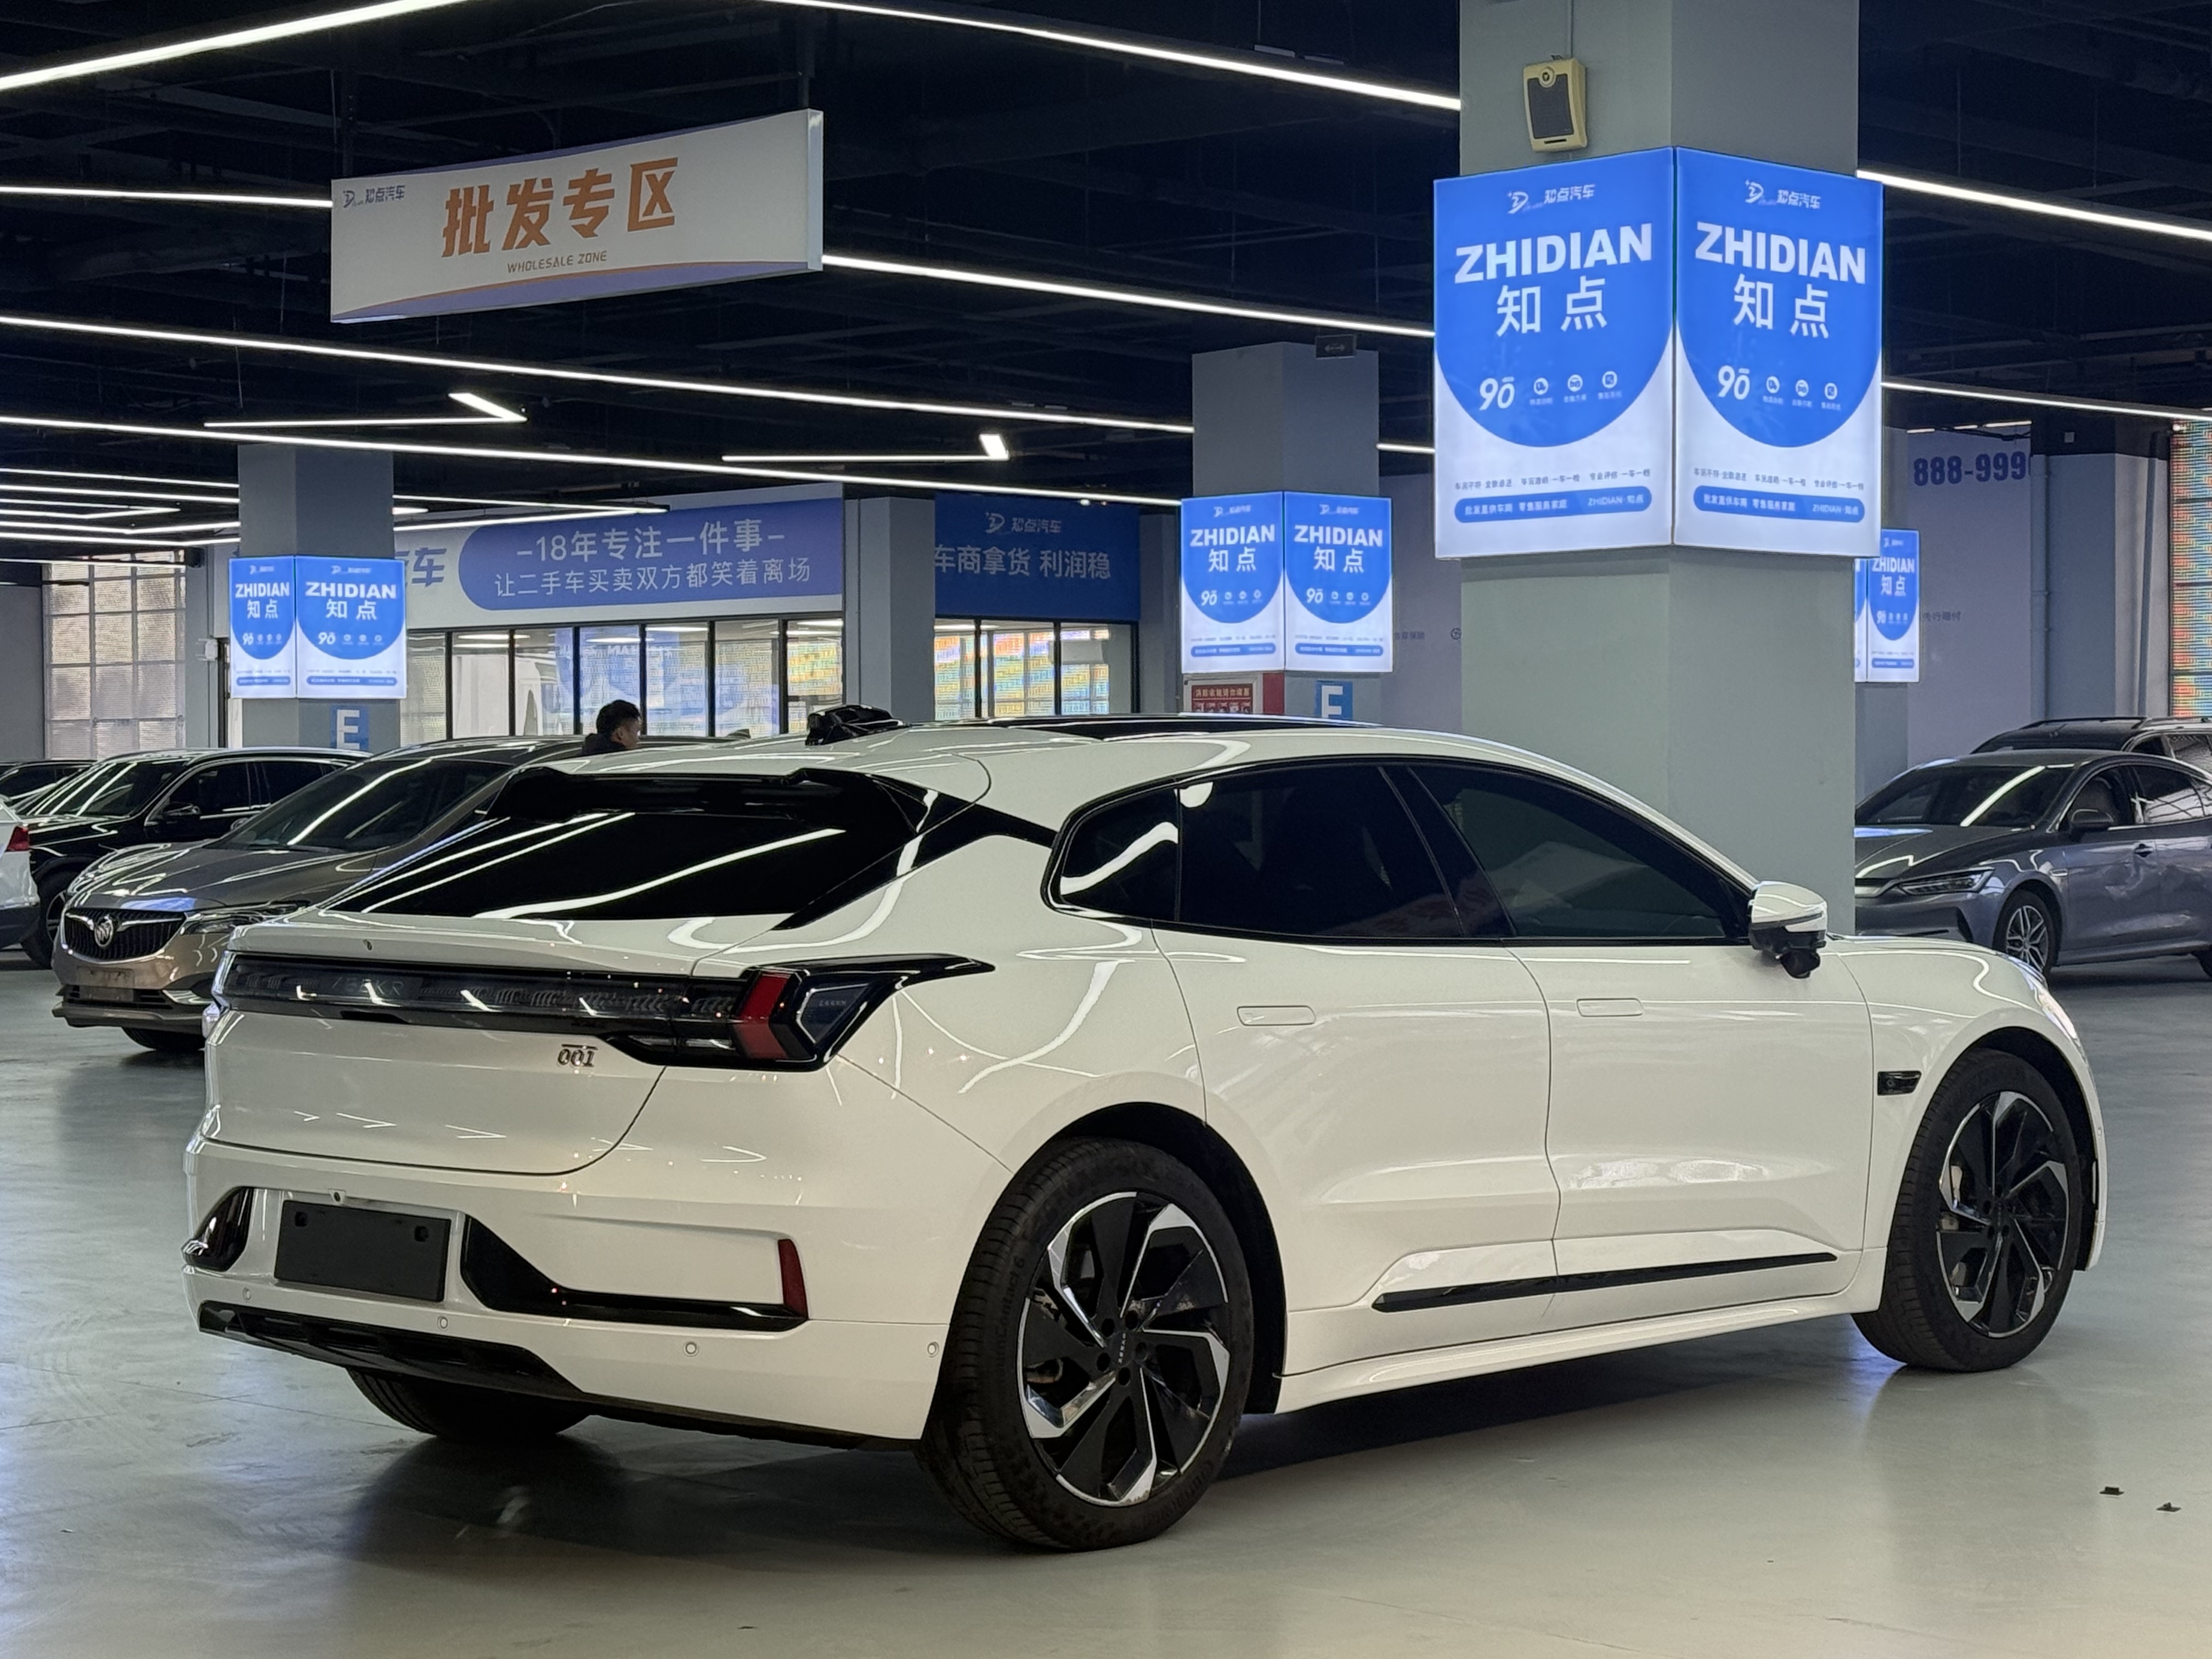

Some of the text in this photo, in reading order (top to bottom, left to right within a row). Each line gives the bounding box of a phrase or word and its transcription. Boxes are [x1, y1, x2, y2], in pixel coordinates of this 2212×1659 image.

[365, 185, 405, 204] 知点汽车
[1544, 184, 1595, 205] 知点汽车
[1776, 189, 1821, 209] 知点汽车
[442, 157, 678, 257] 批发专区
[507, 250, 607, 273] WHOLESALE ZONE
[1455, 223, 1652, 284] ZHIDIAN
[1695, 222, 1865, 284] ZHIDIAN
[1496, 275, 1607, 337] 知点
[1734, 274, 1829, 338] 知点
[1479, 376, 1515, 410] 90
[1717, 365, 1750, 400] 90
[1914, 451, 2031, 486] 888-999
[1012, 517, 1062, 533] 知点汽车
[1190, 524, 1275, 547] ZHIDIAN
[1294, 524, 1383, 546] ZHIDIAN
[395, 548, 447, 588] 车
[934, 544, 1111, 579] 车商拿货 利润稳
[1209, 547, 1256, 572] 知点
[1314, 546, 1364, 573] 知点
[1872, 557, 1915, 573] ZHIDIAN
[494, 556, 811, 599] 让二手车买卖双方都笑着离场
[1881, 574, 1906, 596] 知点
[235, 582, 290, 598] ZHIDIAN
[305, 582, 397, 599] ZHIDIAN
[247, 599, 278, 619] 知点
[326, 599, 377, 620] 知点
[337, 709, 360, 749] E
[557, 1048, 595, 1068] 001
